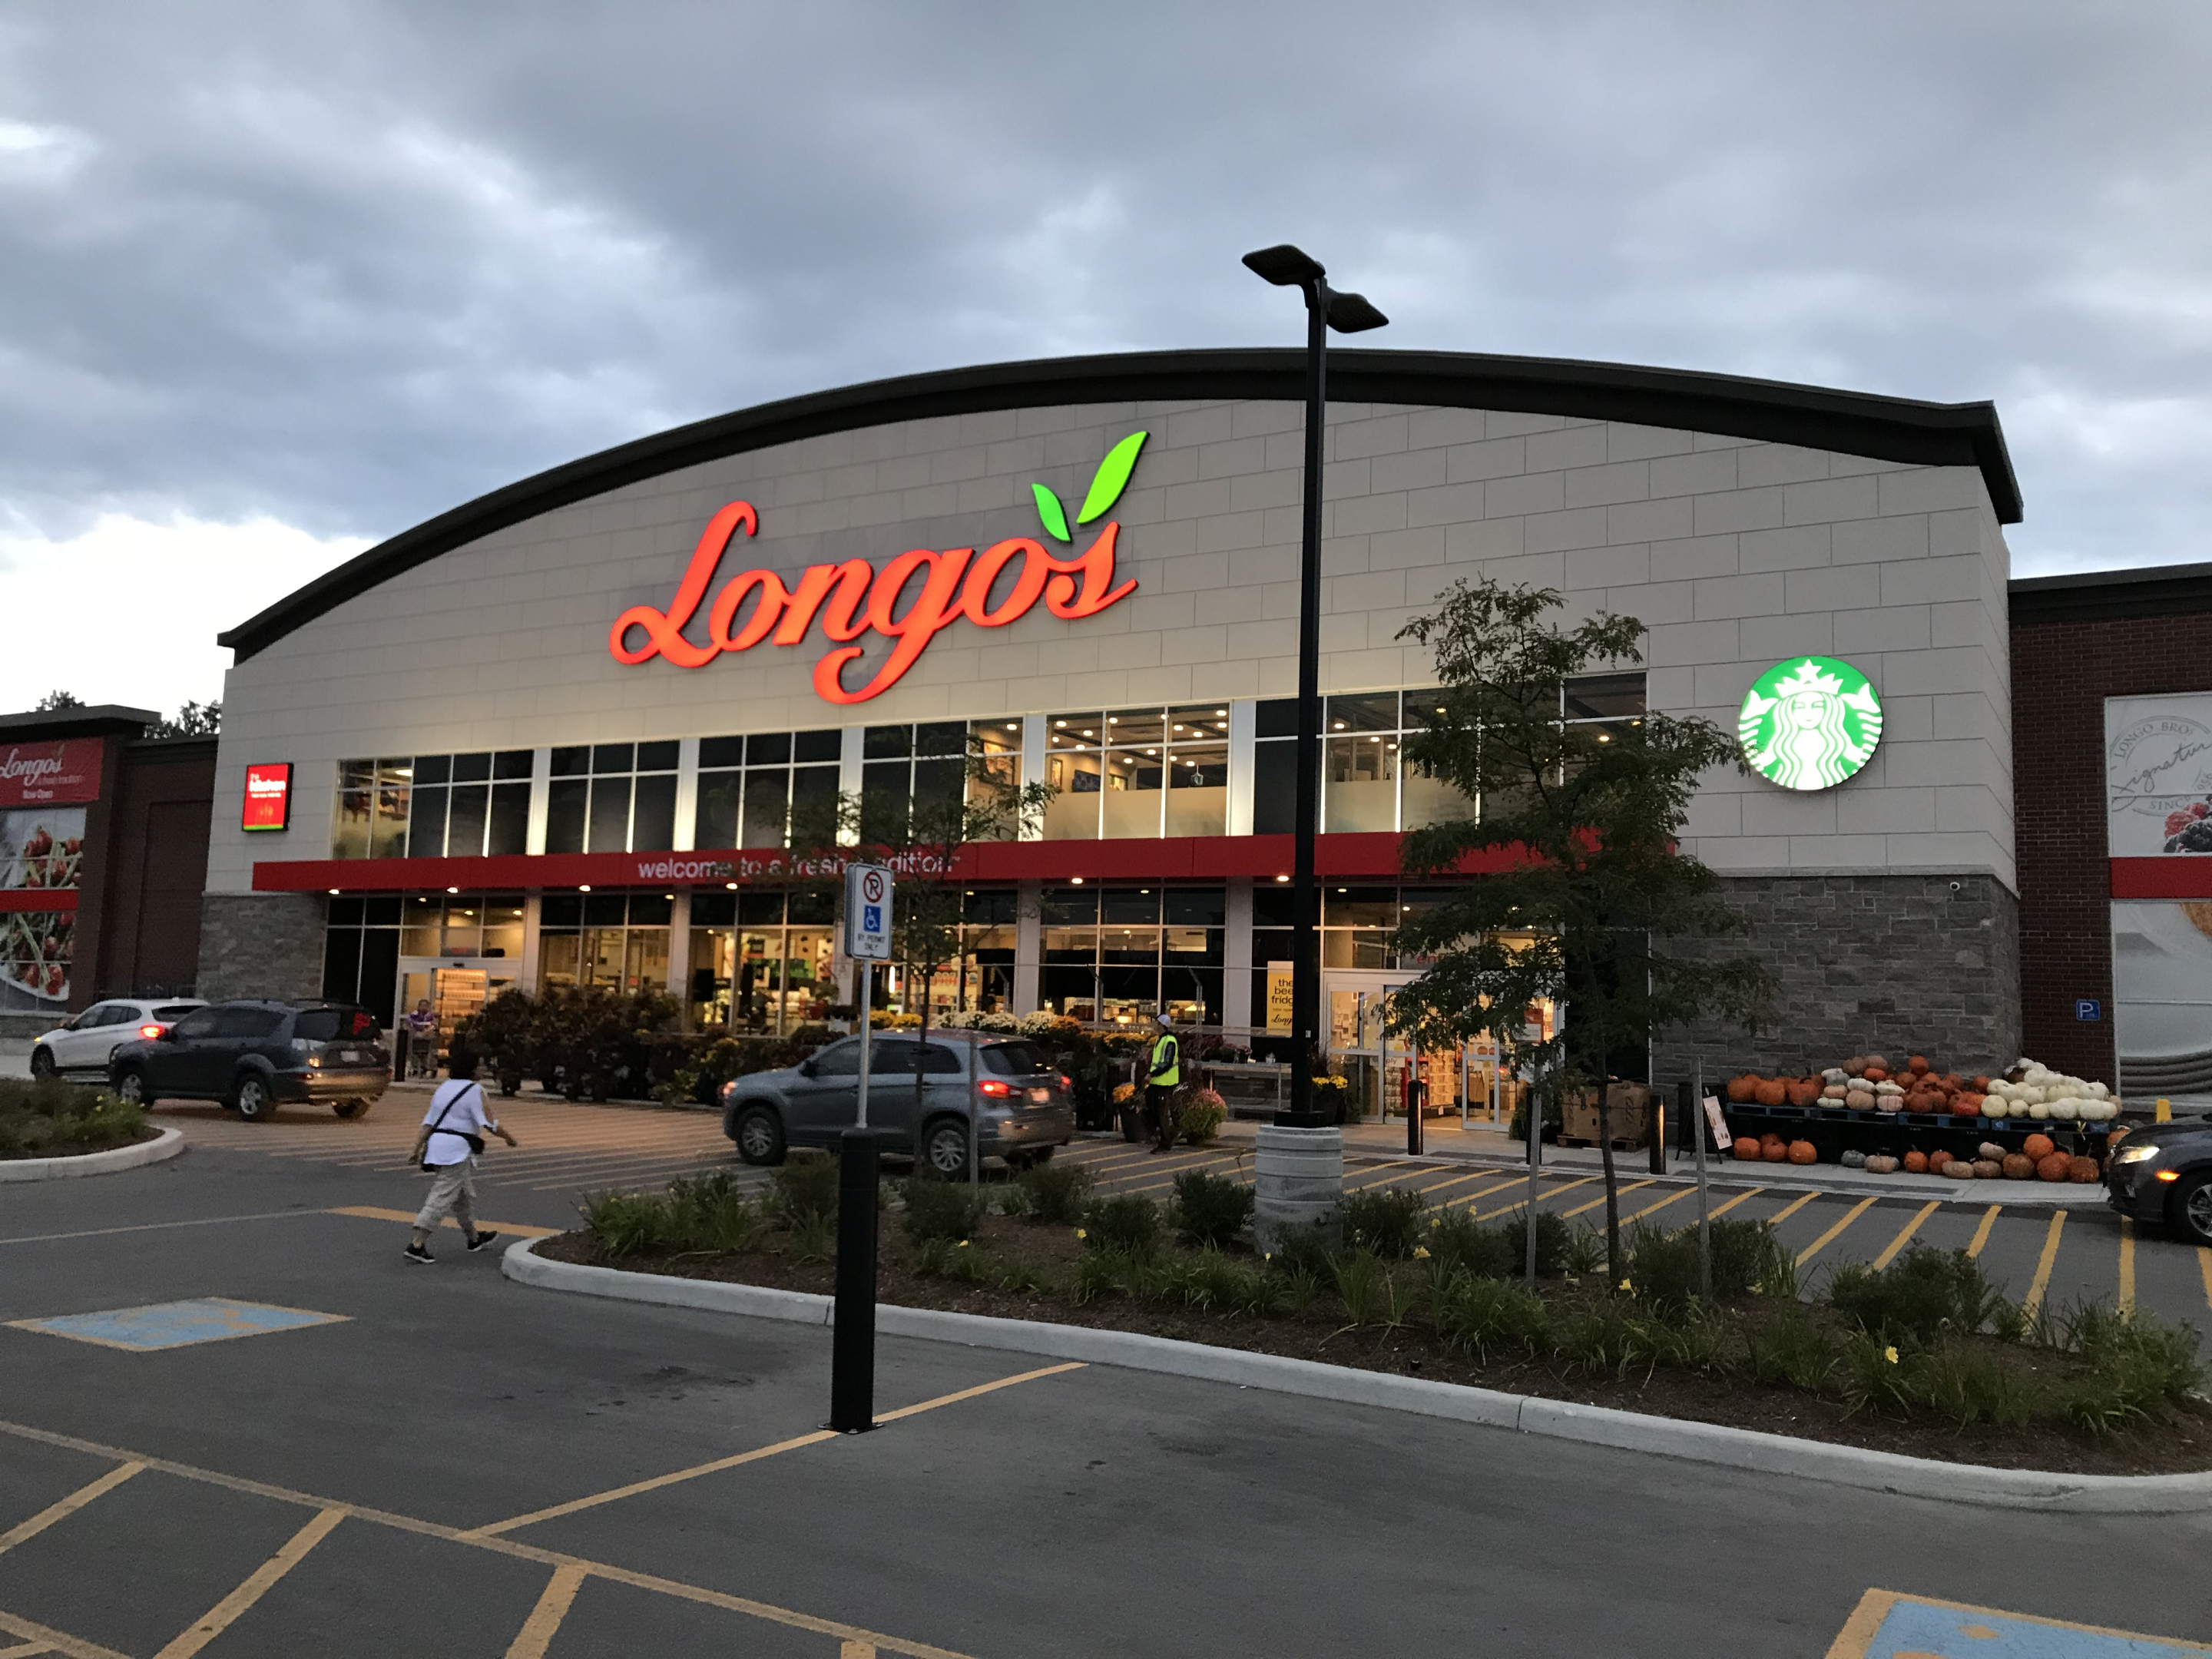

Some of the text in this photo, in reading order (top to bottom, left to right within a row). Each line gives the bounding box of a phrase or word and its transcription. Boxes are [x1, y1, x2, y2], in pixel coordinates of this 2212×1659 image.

[2114, 724, 2154, 758] LONGO
[638, 858, 732, 879] welcome
[740, 856, 762, 876] to
[857, 933, 886, 943] BY PERMIT
[864, 942, 879, 951] ONLY
[1278, 979, 1293, 988] the
[1274, 986, 1293, 995] bee
[1271, 995, 1293, 1006] fridg
[2079, 1002, 2093, 1018] P
